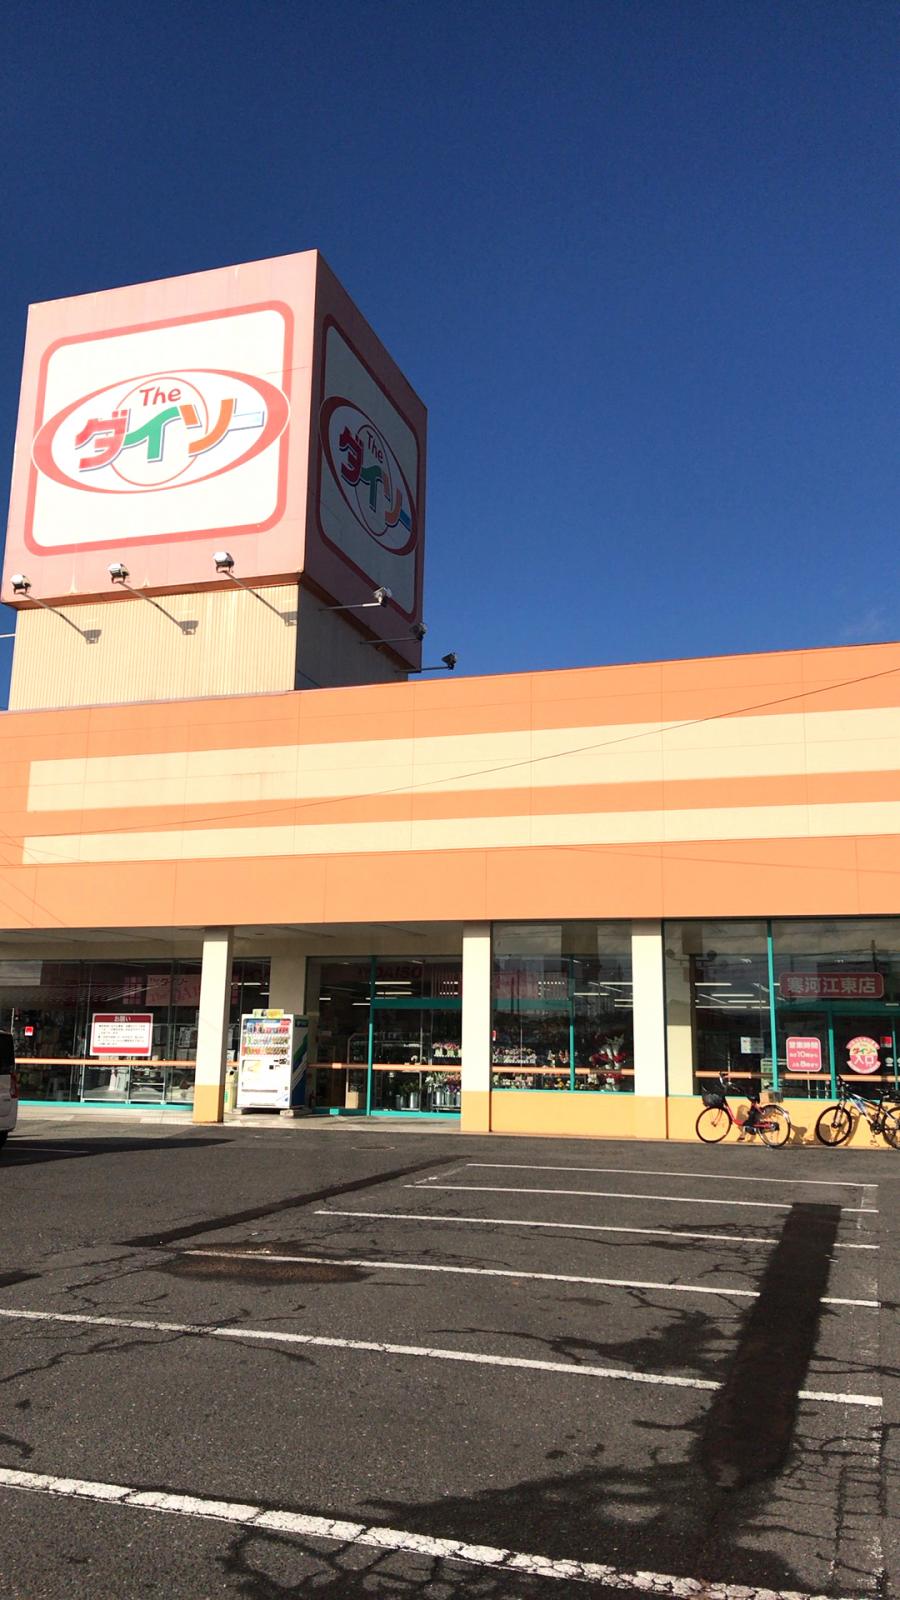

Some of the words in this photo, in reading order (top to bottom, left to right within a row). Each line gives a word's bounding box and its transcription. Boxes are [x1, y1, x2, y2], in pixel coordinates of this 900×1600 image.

[139, 386, 182, 407] The
[75, 398, 264, 472] ダイソー
[367, 431, 384, 463] The
[339, 426, 411, 531] ダイソー
[786, 976, 876, 993] 寒河江東店
[854, 1055, 874, 1064] 入口
